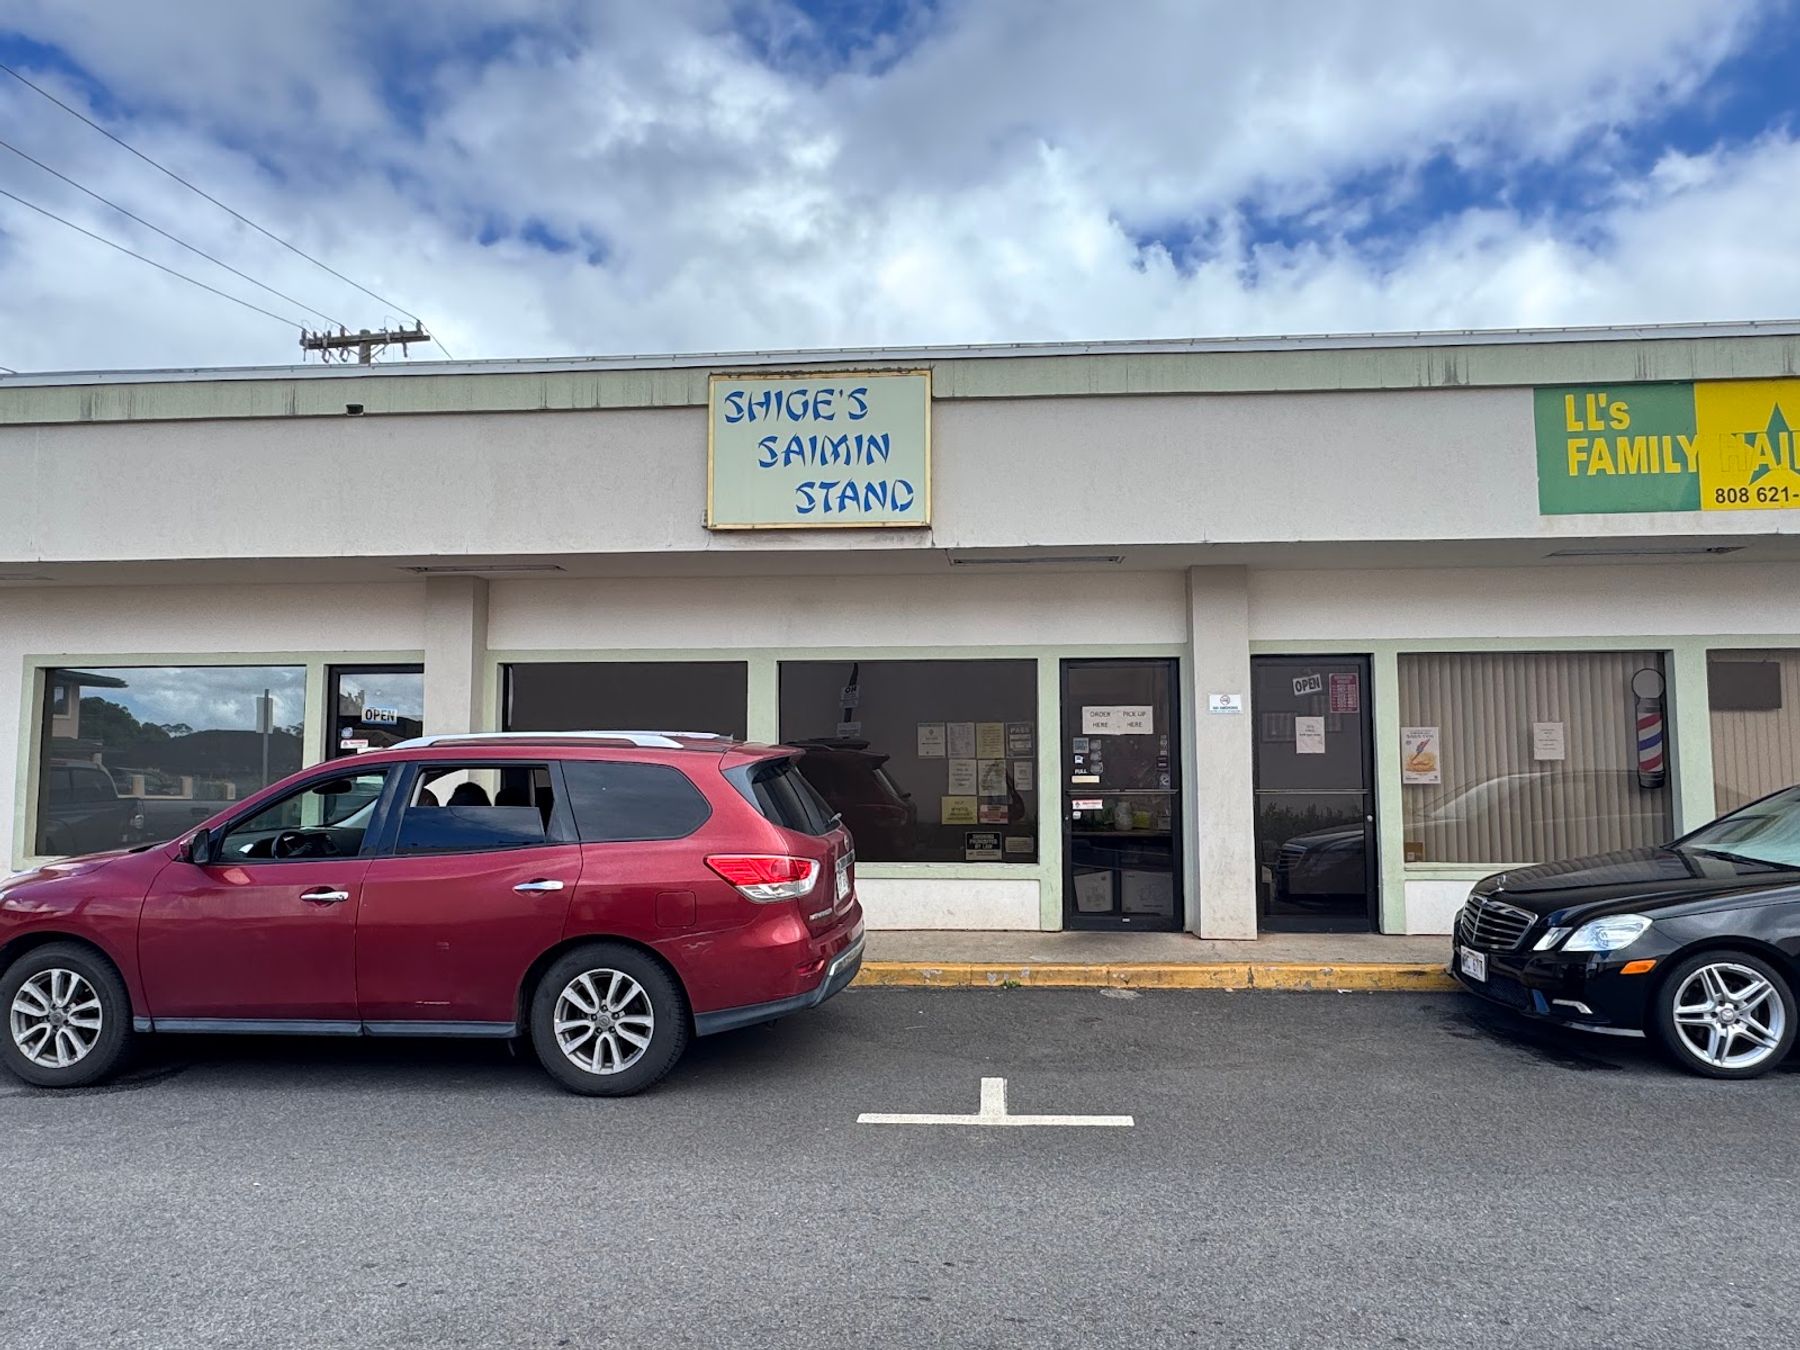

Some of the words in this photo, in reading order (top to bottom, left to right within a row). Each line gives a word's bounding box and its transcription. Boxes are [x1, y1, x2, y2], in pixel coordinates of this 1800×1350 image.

[724, 387, 868, 423] SHIGE'S
[1564, 393, 1631, 432] LL's
[758, 433, 890, 468] SAIMIN
[1567, 434, 1700, 477] FAMILY
[795, 477, 914, 514] STAND
[1715, 488, 1750, 504] 808
[1295, 677, 1321, 693] OPEN
[365, 709, 395, 722] OPEN
